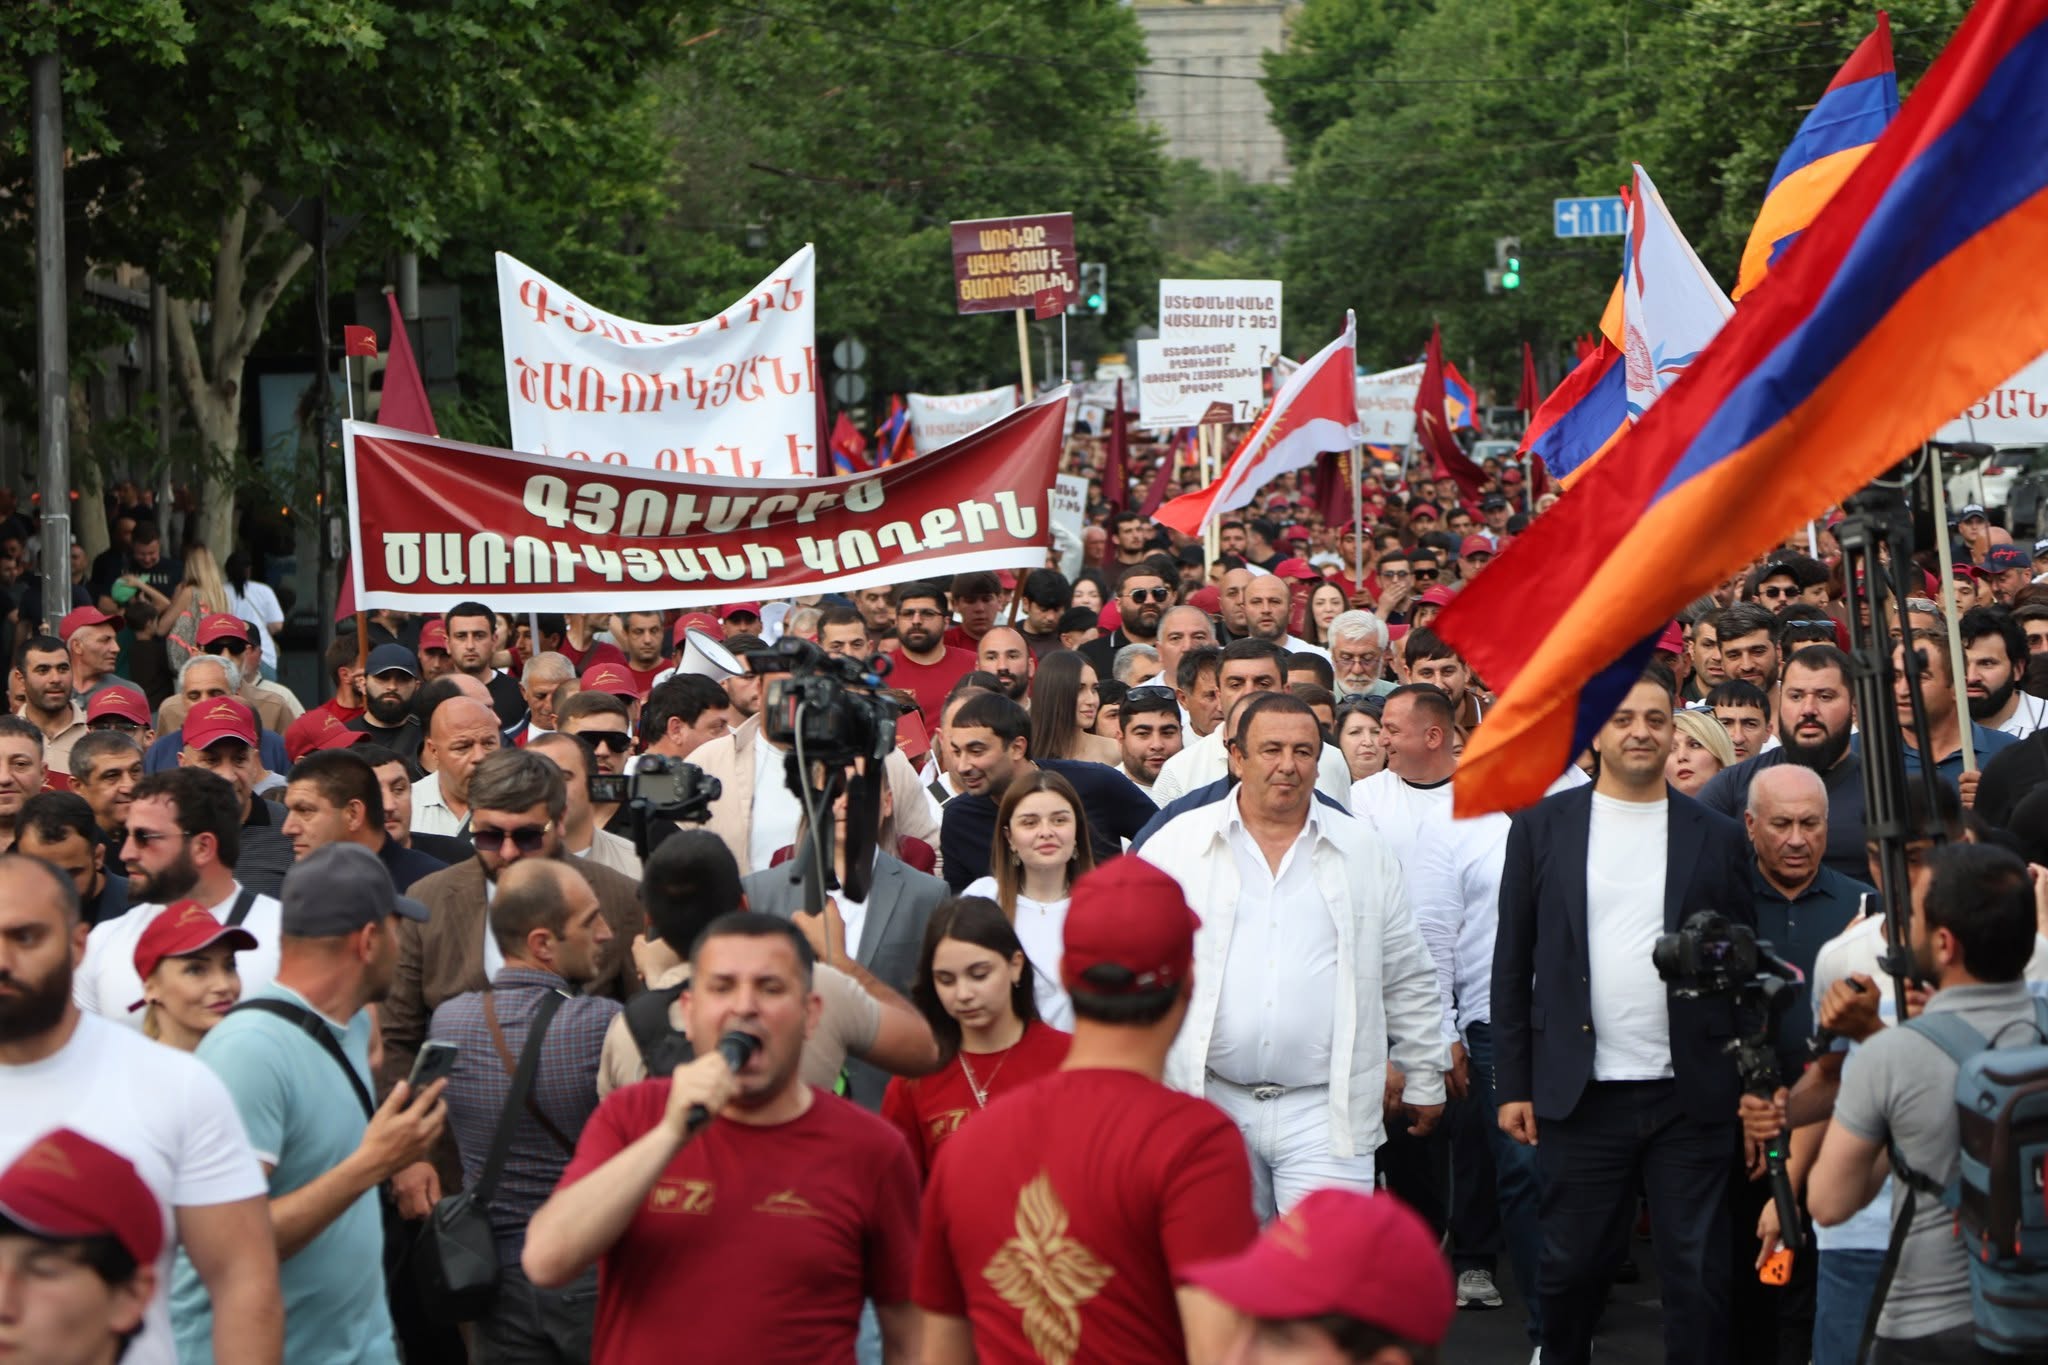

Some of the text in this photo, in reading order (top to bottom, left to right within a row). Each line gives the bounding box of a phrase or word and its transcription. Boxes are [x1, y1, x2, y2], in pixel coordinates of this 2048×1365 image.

[1051, 248, 1064, 270] Է
[1237, 315, 1246, 328] Է
[784, 433, 815, 477] Է
[382, 491, 1038, 586] ԾԱՌՈՒԿՅԱՆԻ ԿՈՂՔԻՆ
